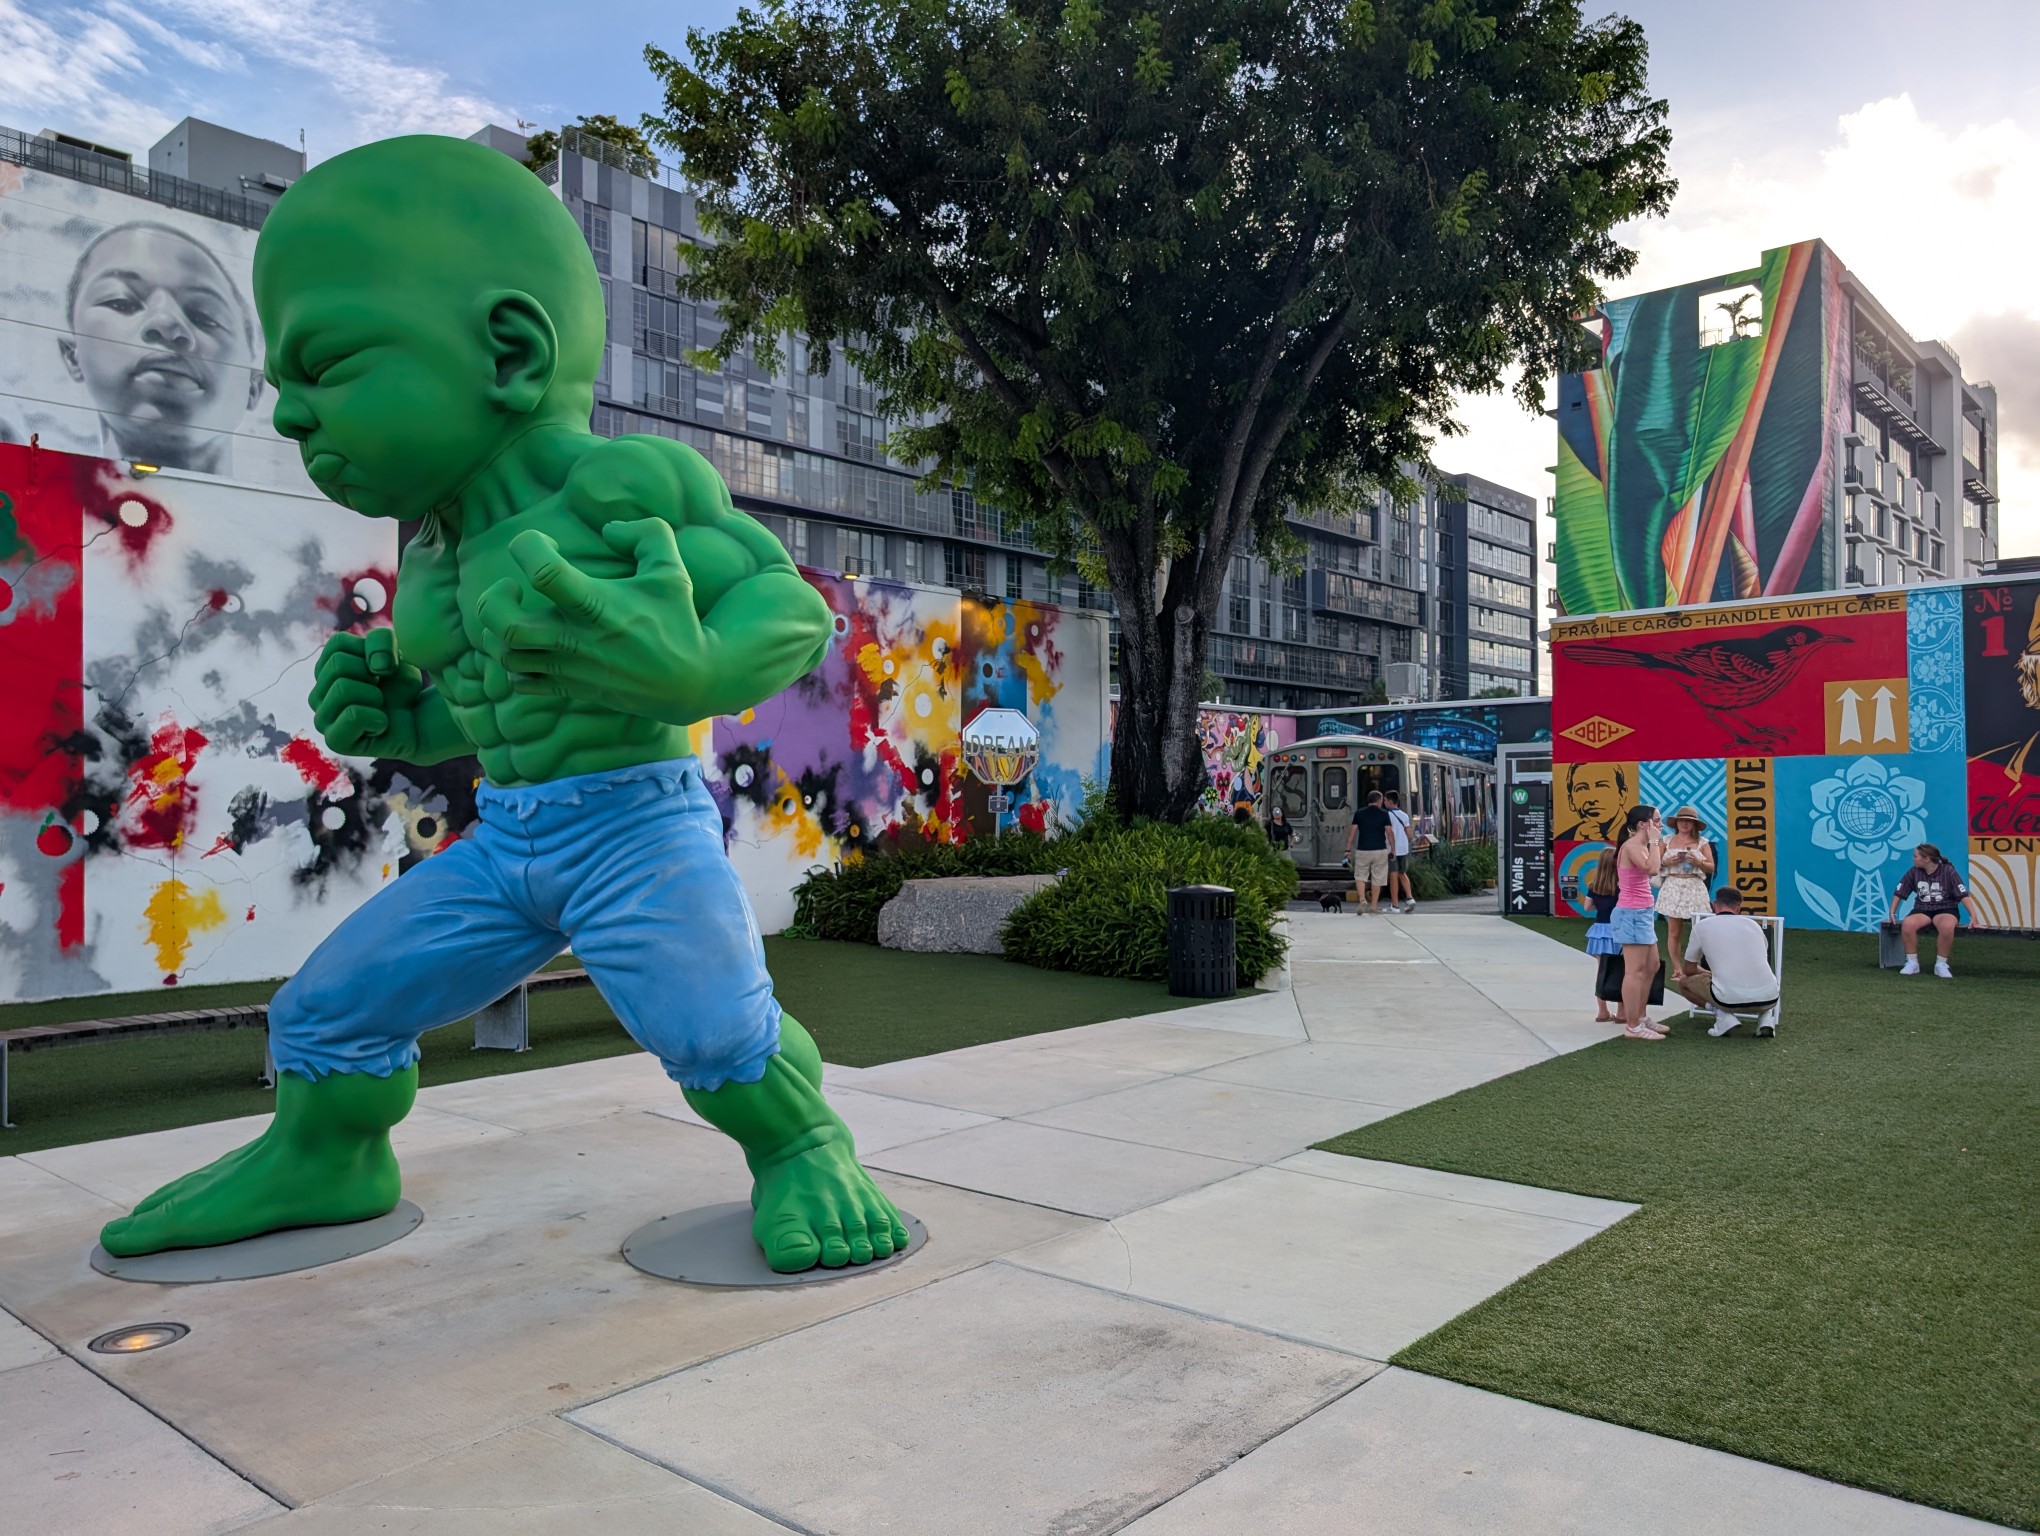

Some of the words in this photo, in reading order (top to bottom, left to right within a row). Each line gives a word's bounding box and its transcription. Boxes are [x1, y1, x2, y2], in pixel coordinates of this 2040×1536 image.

[1559, 621, 1627, 638] FRAGILE
[1633, 617, 1692, 631] CARGO
[1705, 608, 1780, 626] HANDLE
[1787, 604, 1838, 618] WITH
[1845, 598, 1900, 613] CARE
[1980, 616, 2009, 657] 1
[971, 734, 1031, 757] DREAM
[1574, 720, 1620, 743] OBEY
[1514, 792, 1525, 801] W
[1734, 758, 1767, 852] ABOVE
[1974, 837, 2040, 852] TON
[1512, 857, 1524, 892] Walls
